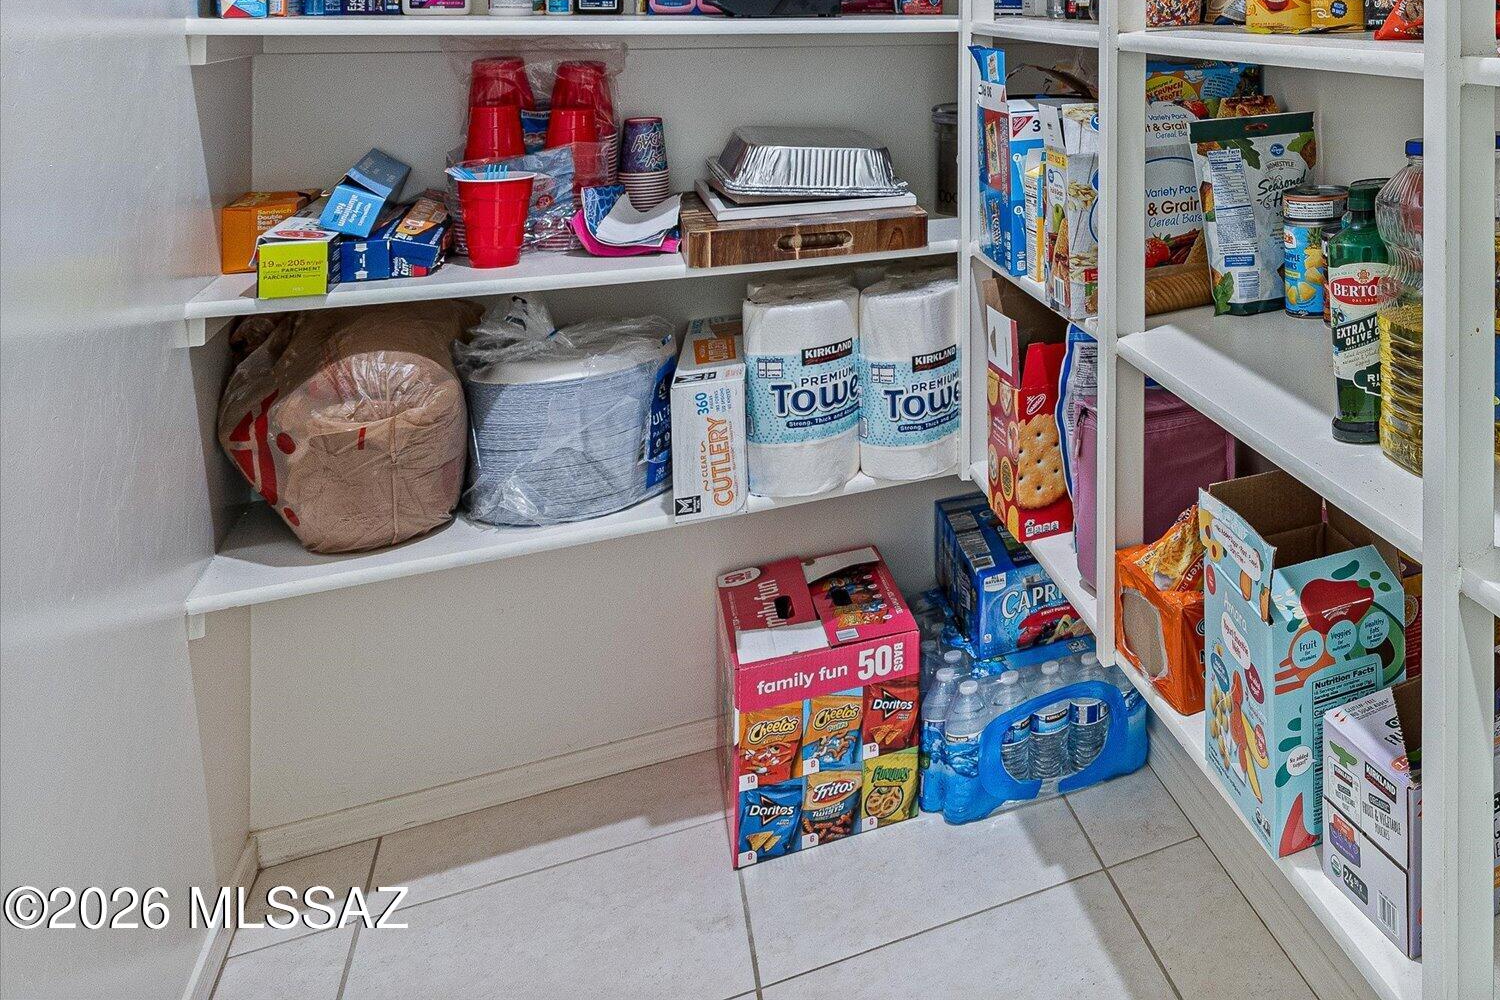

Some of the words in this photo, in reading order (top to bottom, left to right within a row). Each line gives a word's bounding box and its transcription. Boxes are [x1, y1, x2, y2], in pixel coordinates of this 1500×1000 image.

[1153, 123, 1160, 132] &
[1156, 131, 1176, 139] Cereal
[1145, 186, 1177, 198] Variety
[1257, 173, 1306, 196] Seasoned
[1148, 203, 1157, 216] &
[1149, 217, 1179, 228] Cereal
[1183, 213, 1202, 223] Bars
[262, 260, 274, 268] 19
[1337, 321, 1365, 339] EXTRA
[1346, 330, 1372, 346] OLIVE
[805, 339, 852, 360] KIRKLAND
[915, 347, 956, 366] KIRKLAND
[801, 367, 854, 387] PREMIUM
[911, 372, 959, 391] PREMIUM
[696, 392, 709, 415] 360
[771, 375, 858, 416] Towe
[884, 382, 960, 420] Towe
[789, 419, 813, 428] Strong,
[815, 415, 832, 426] Thick
[707, 417, 733, 507] CUTLERY
[1330, 628, 1351, 641] Veggies
[1364, 618, 1385, 633] Healthy
[1299, 639, 1318, 653] Fruit
[894, 642, 903, 671] BAGS
[757, 673, 813, 695] family
[819, 665, 848, 686] fun
[858, 645, 893, 681] 50
[1314, 671, 1350, 690] Nutrition
[1353, 665, 1375, 679] Facts
[873, 697, 913, 712] Doritos
[813, 702, 859, 730] Cheetos
[748, 716, 799, 744] Cheetos
[868, 744, 877, 753] 12
[747, 775, 756, 785] 10
[1366, 762, 1397, 798] KIRKLAND
[813, 780, 855, 803] Fritos
[750, 803, 795, 819] Doritos
[1363, 802, 1373, 819] FRUIT
